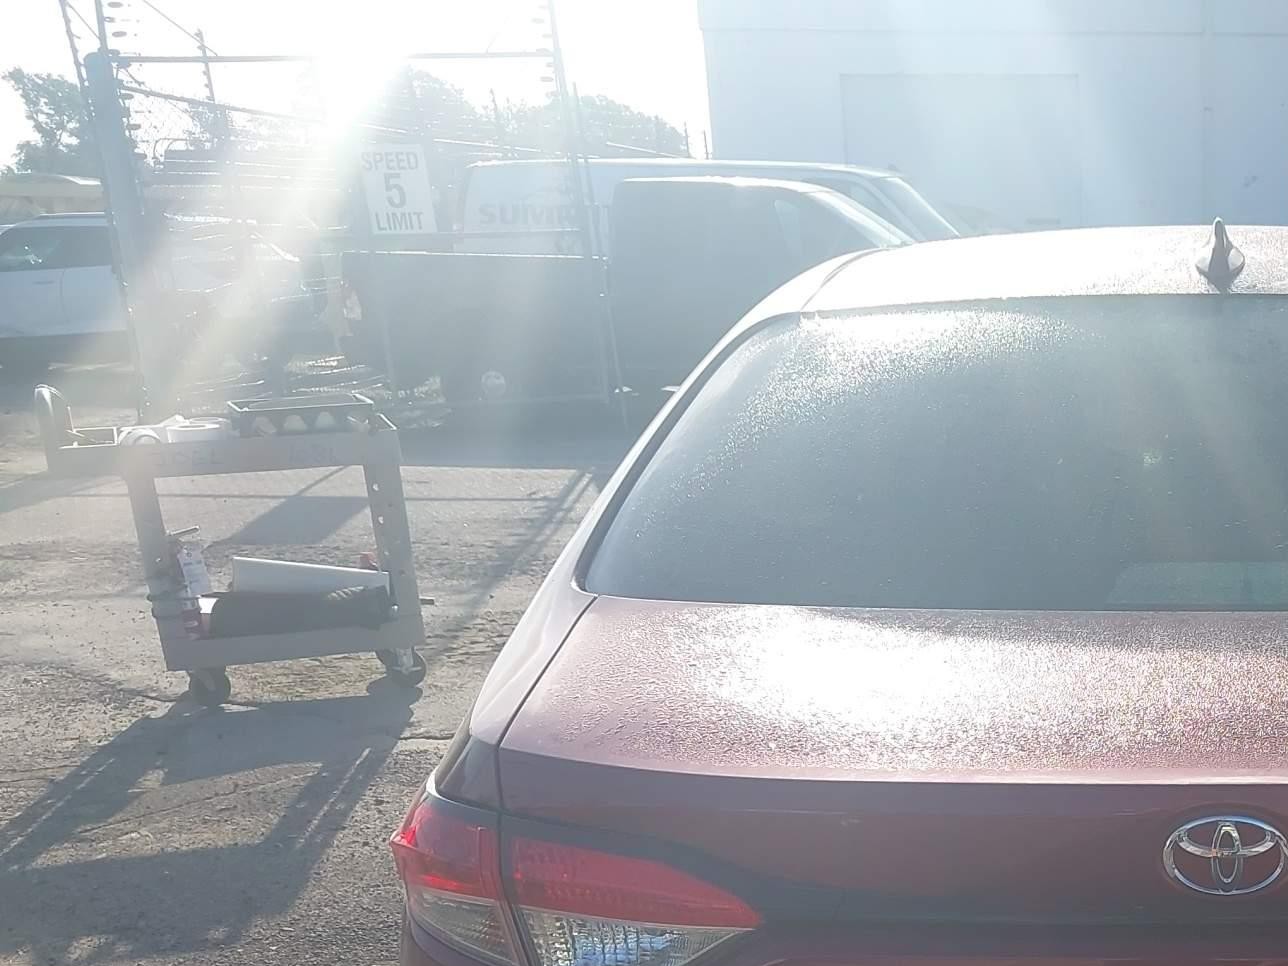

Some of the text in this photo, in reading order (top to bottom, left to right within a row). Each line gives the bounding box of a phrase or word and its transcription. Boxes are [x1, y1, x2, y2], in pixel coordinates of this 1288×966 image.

[361, 151, 418, 171] SPEED
[384, 172, 407, 209] 5
[375, 211, 424, 232] LIMIT
